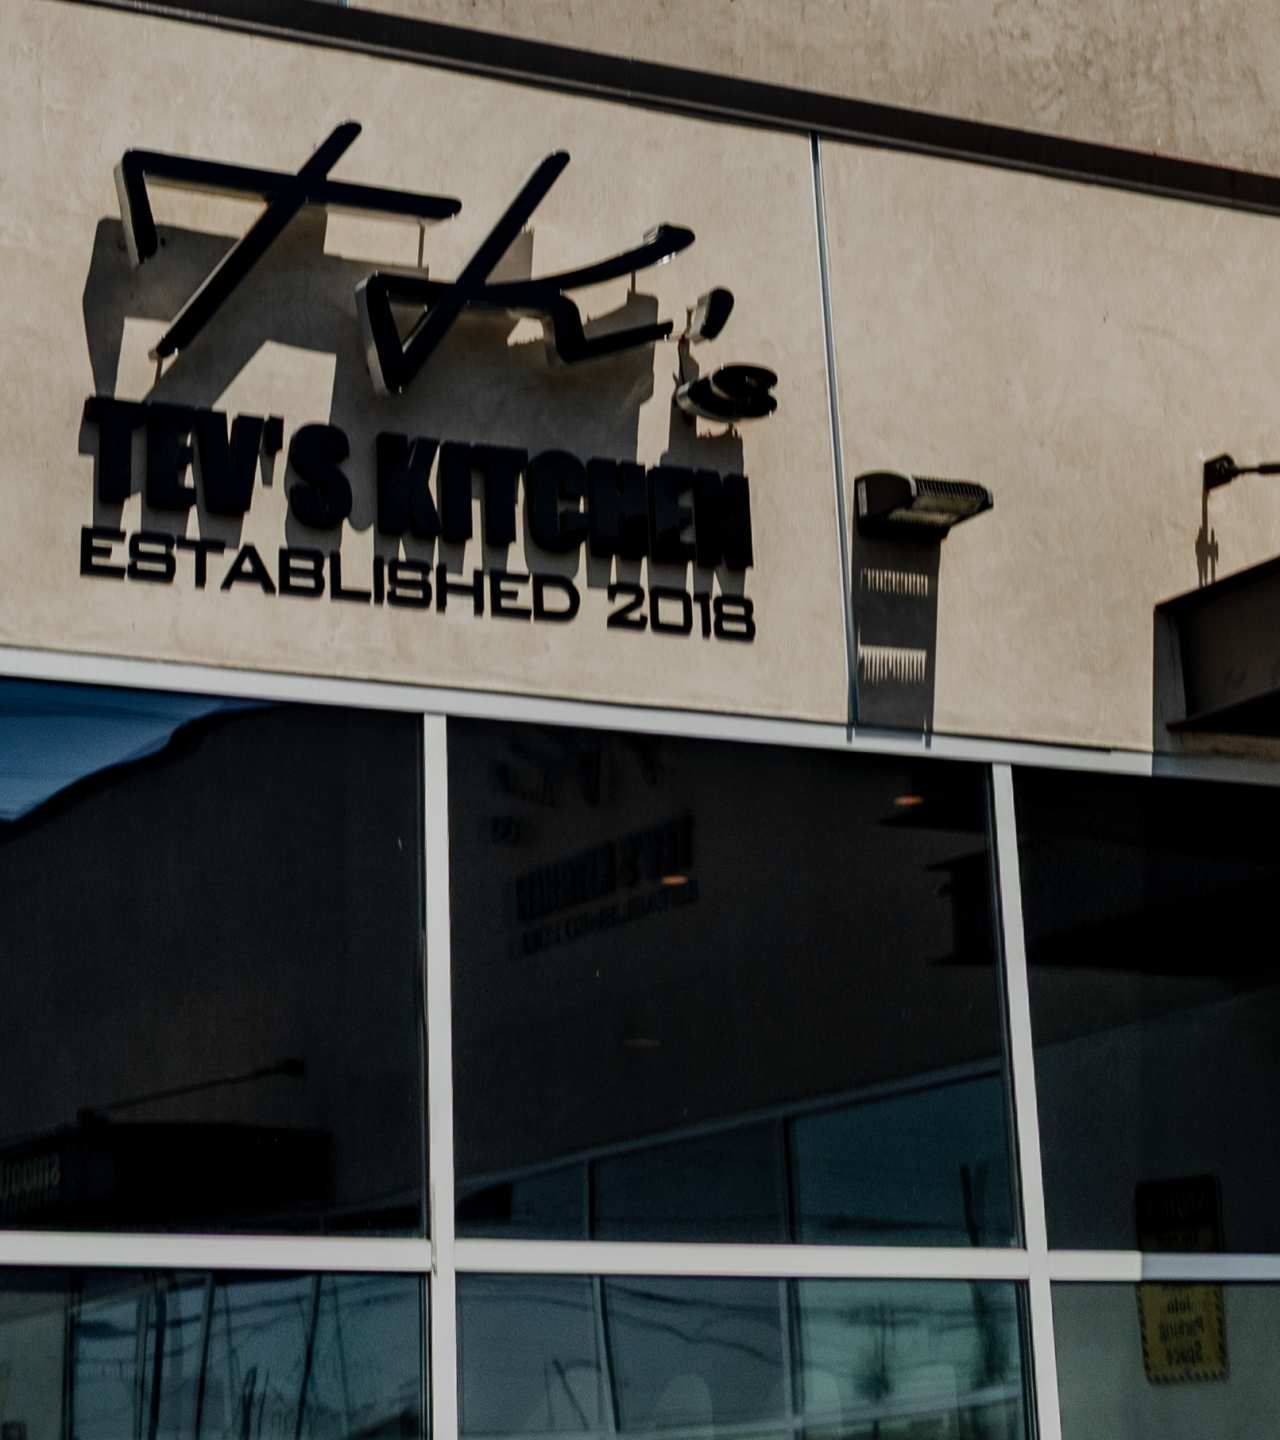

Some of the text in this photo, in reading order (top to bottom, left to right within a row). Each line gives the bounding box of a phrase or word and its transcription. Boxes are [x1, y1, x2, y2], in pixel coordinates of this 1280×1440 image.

[81, 396, 755, 571] TEV'S KITCHEN
[79, 526, 757, 643] ESTABLISHED 2018
